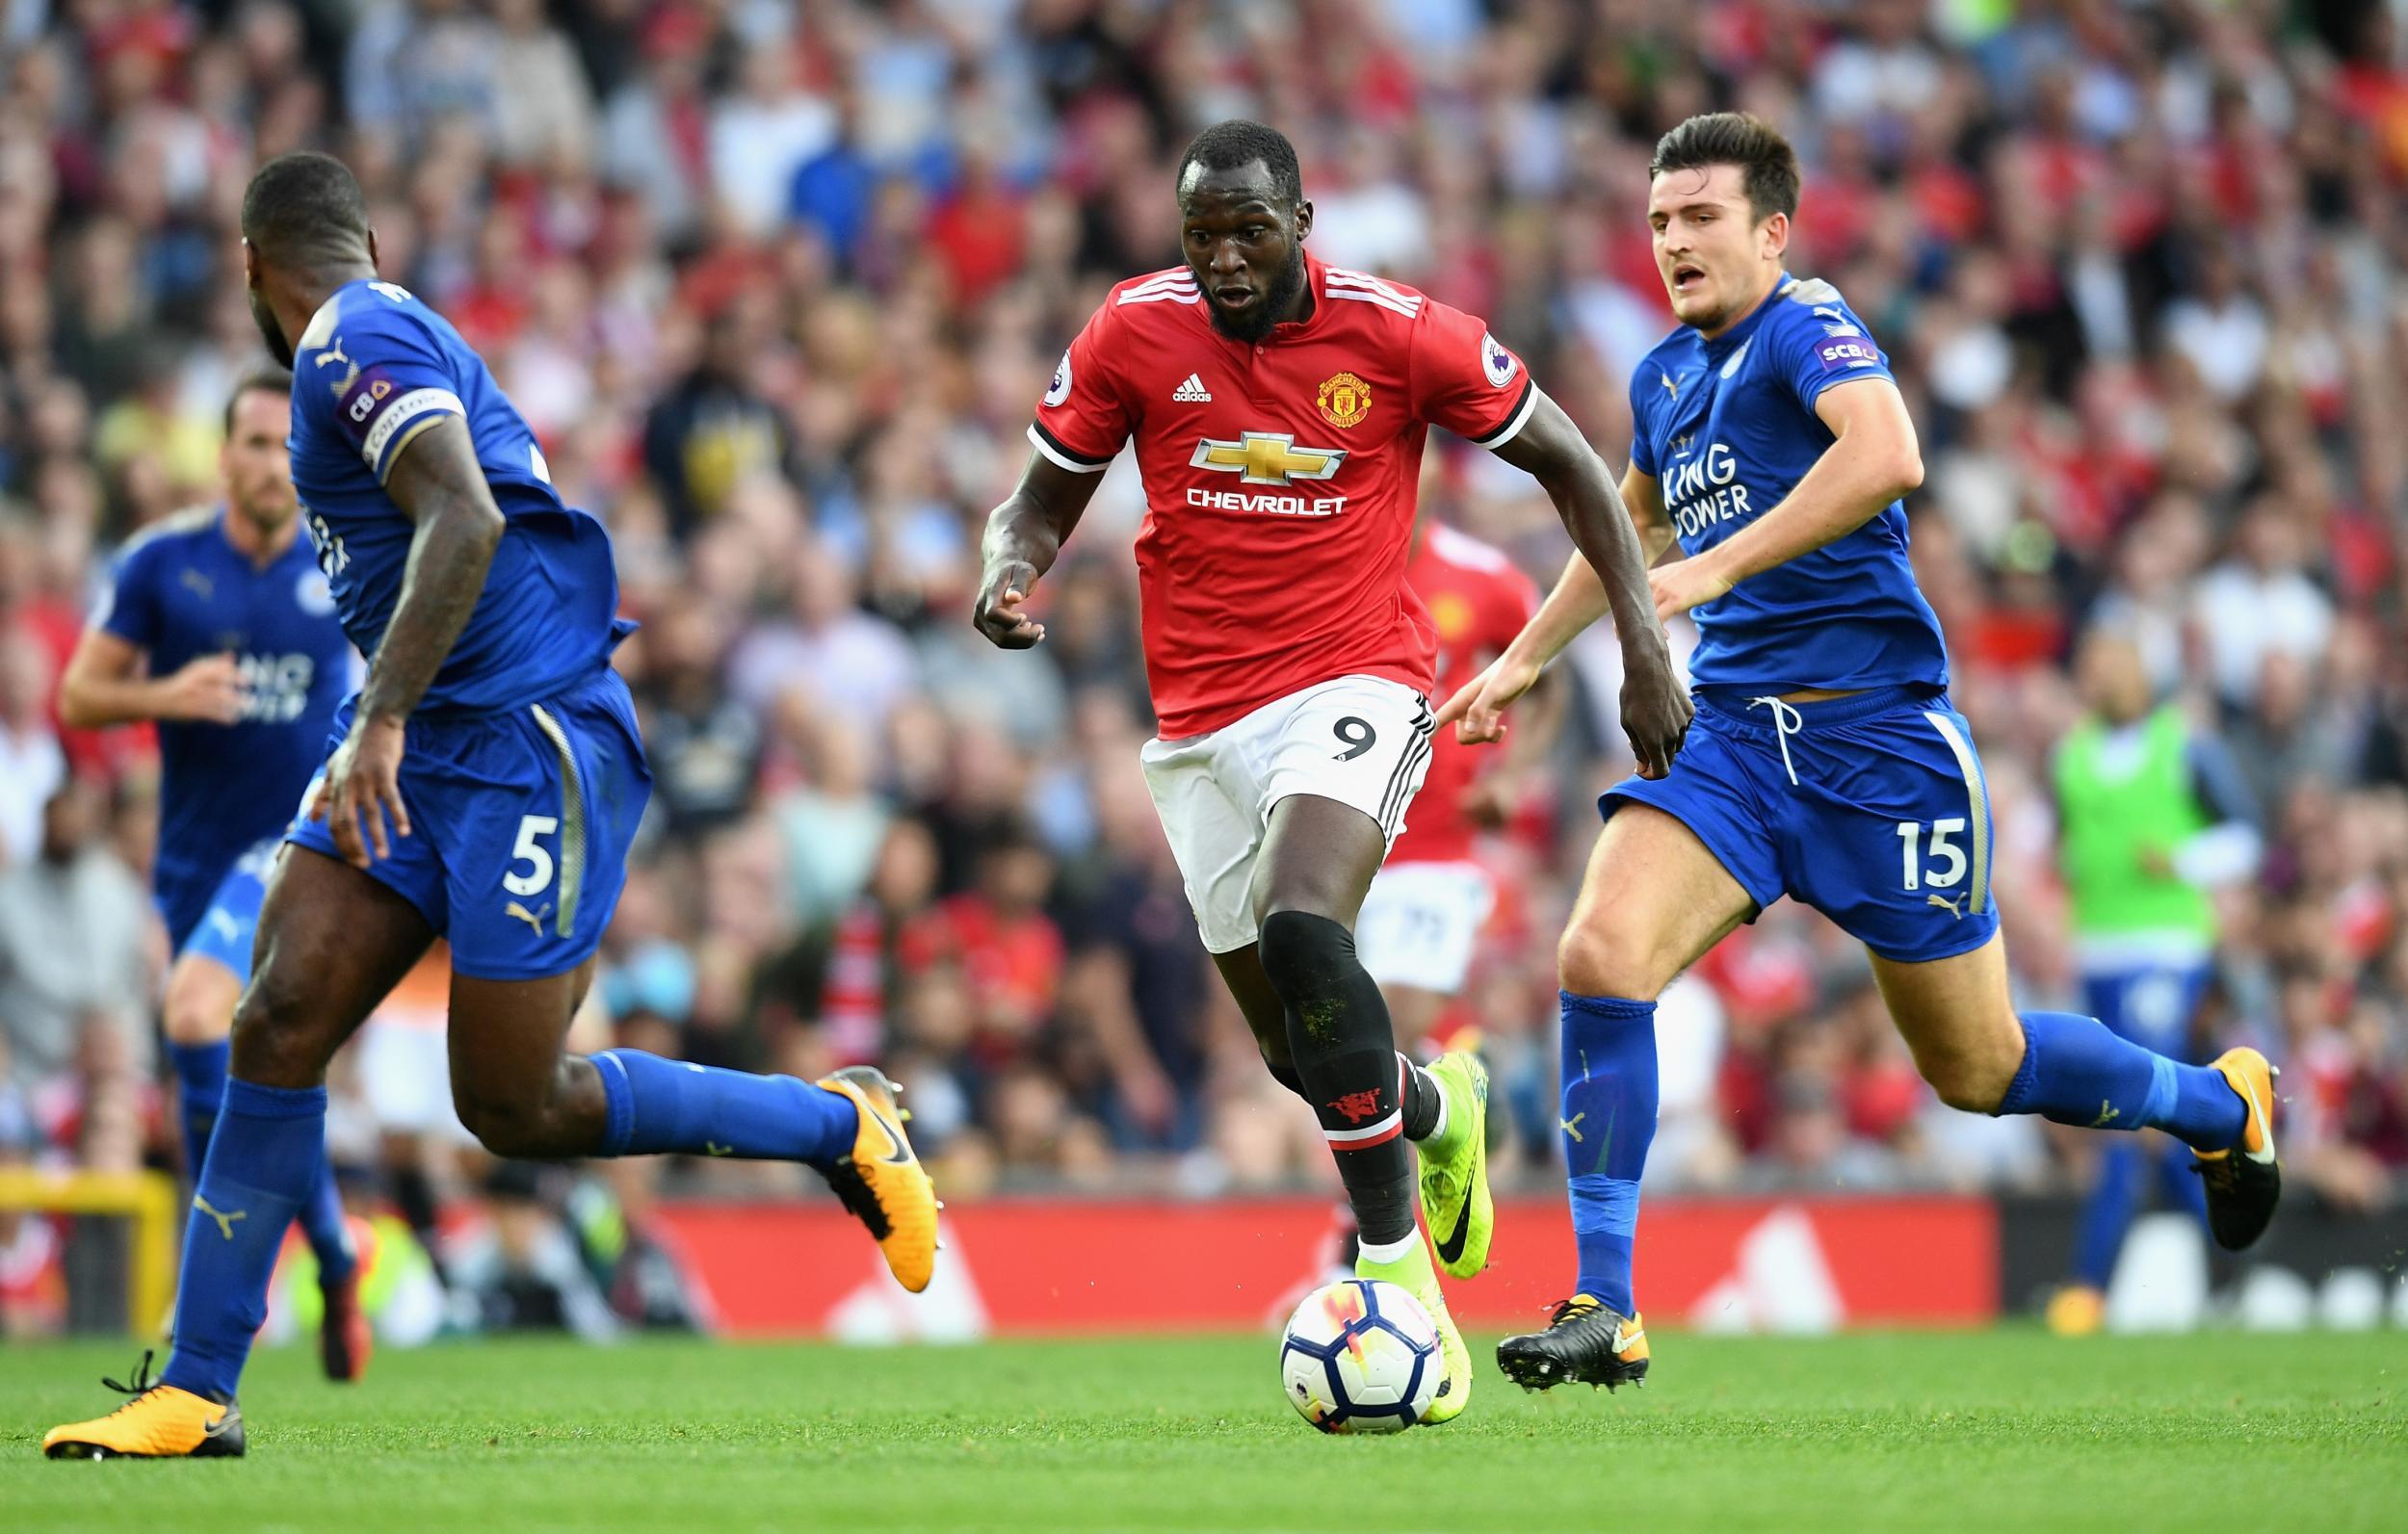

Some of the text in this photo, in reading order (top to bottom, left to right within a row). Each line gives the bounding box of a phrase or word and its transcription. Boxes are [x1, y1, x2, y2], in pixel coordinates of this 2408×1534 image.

[1822, 344, 1863, 361] SCB
[1172, 391, 1212, 403] adidas
[1322, 376, 1367, 396] MANCHESTER
[1329, 414, 1360, 424] UNITED
[1662, 444, 1736, 511] KING
[1187, 488, 1348, 516] CHEVROLET
[1331, 716, 1376, 762] 9
[502, 815, 559, 897] 5
[1897, 818, 1967, 891] 15
